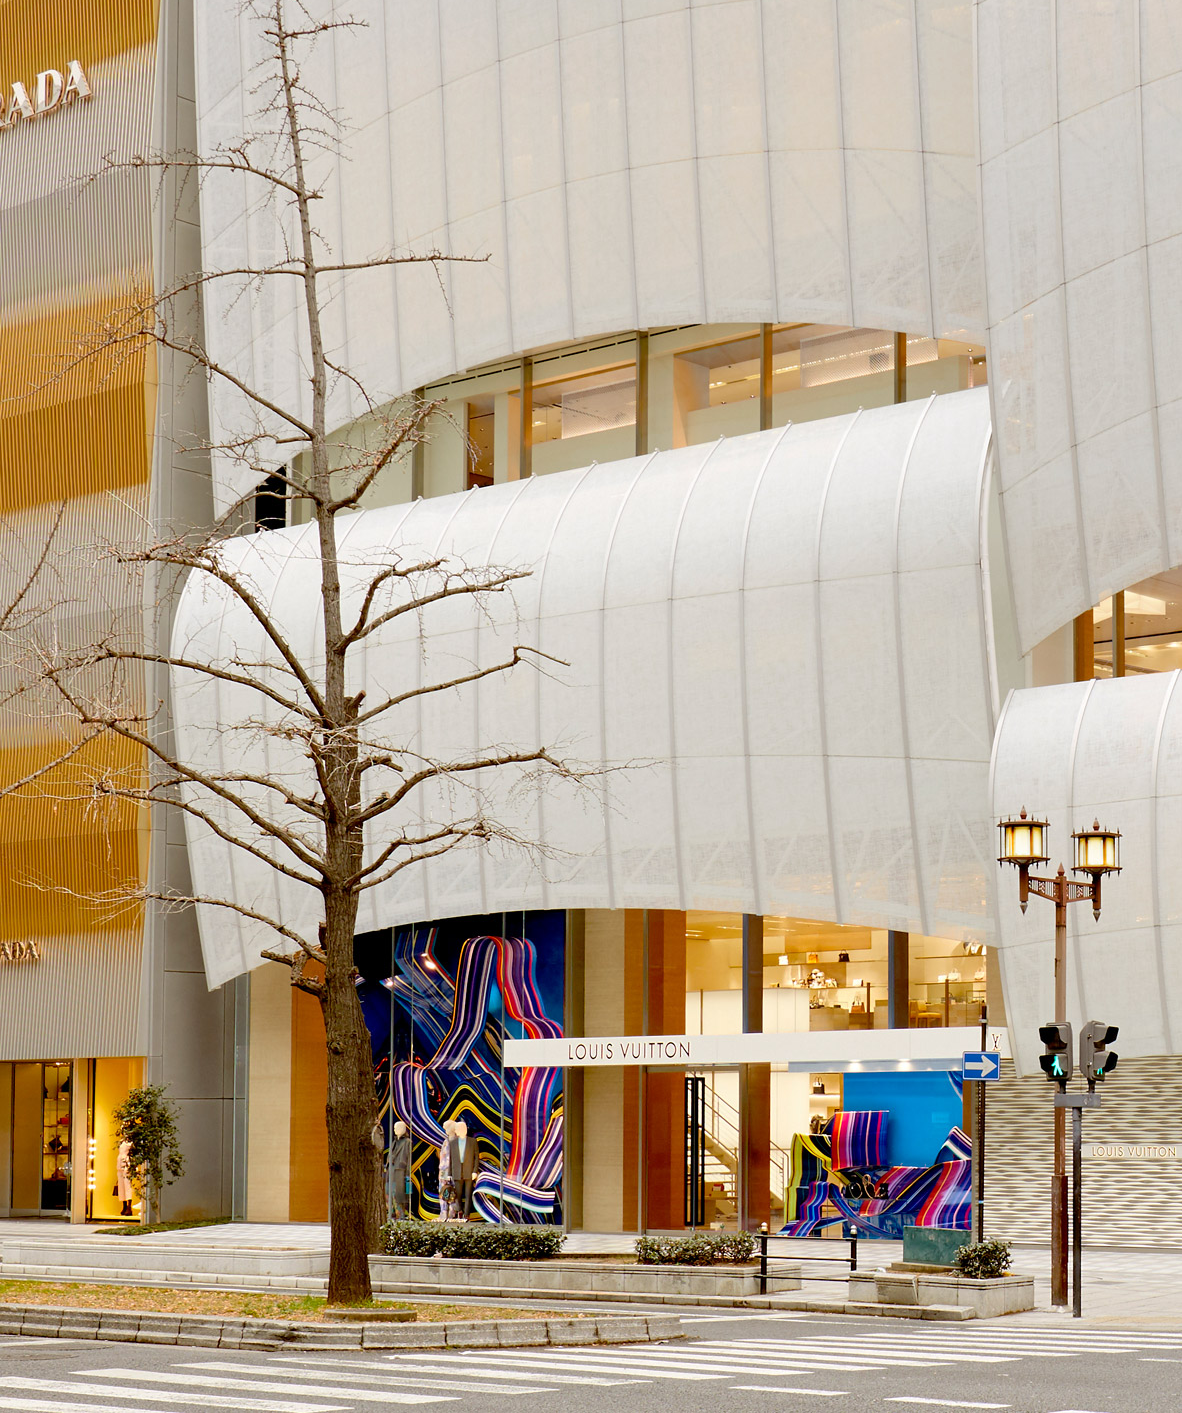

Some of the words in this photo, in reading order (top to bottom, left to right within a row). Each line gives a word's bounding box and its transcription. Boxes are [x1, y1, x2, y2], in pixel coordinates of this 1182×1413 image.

[0, 59, 94, 129] ADA
[568, 1043, 613, 1060] LOUIS
[620, 1042, 690, 1059] VUITTON
[1092, 1146, 1124, 1157] LOUIS
[1127, 1146, 1176, 1157] VUITTON
